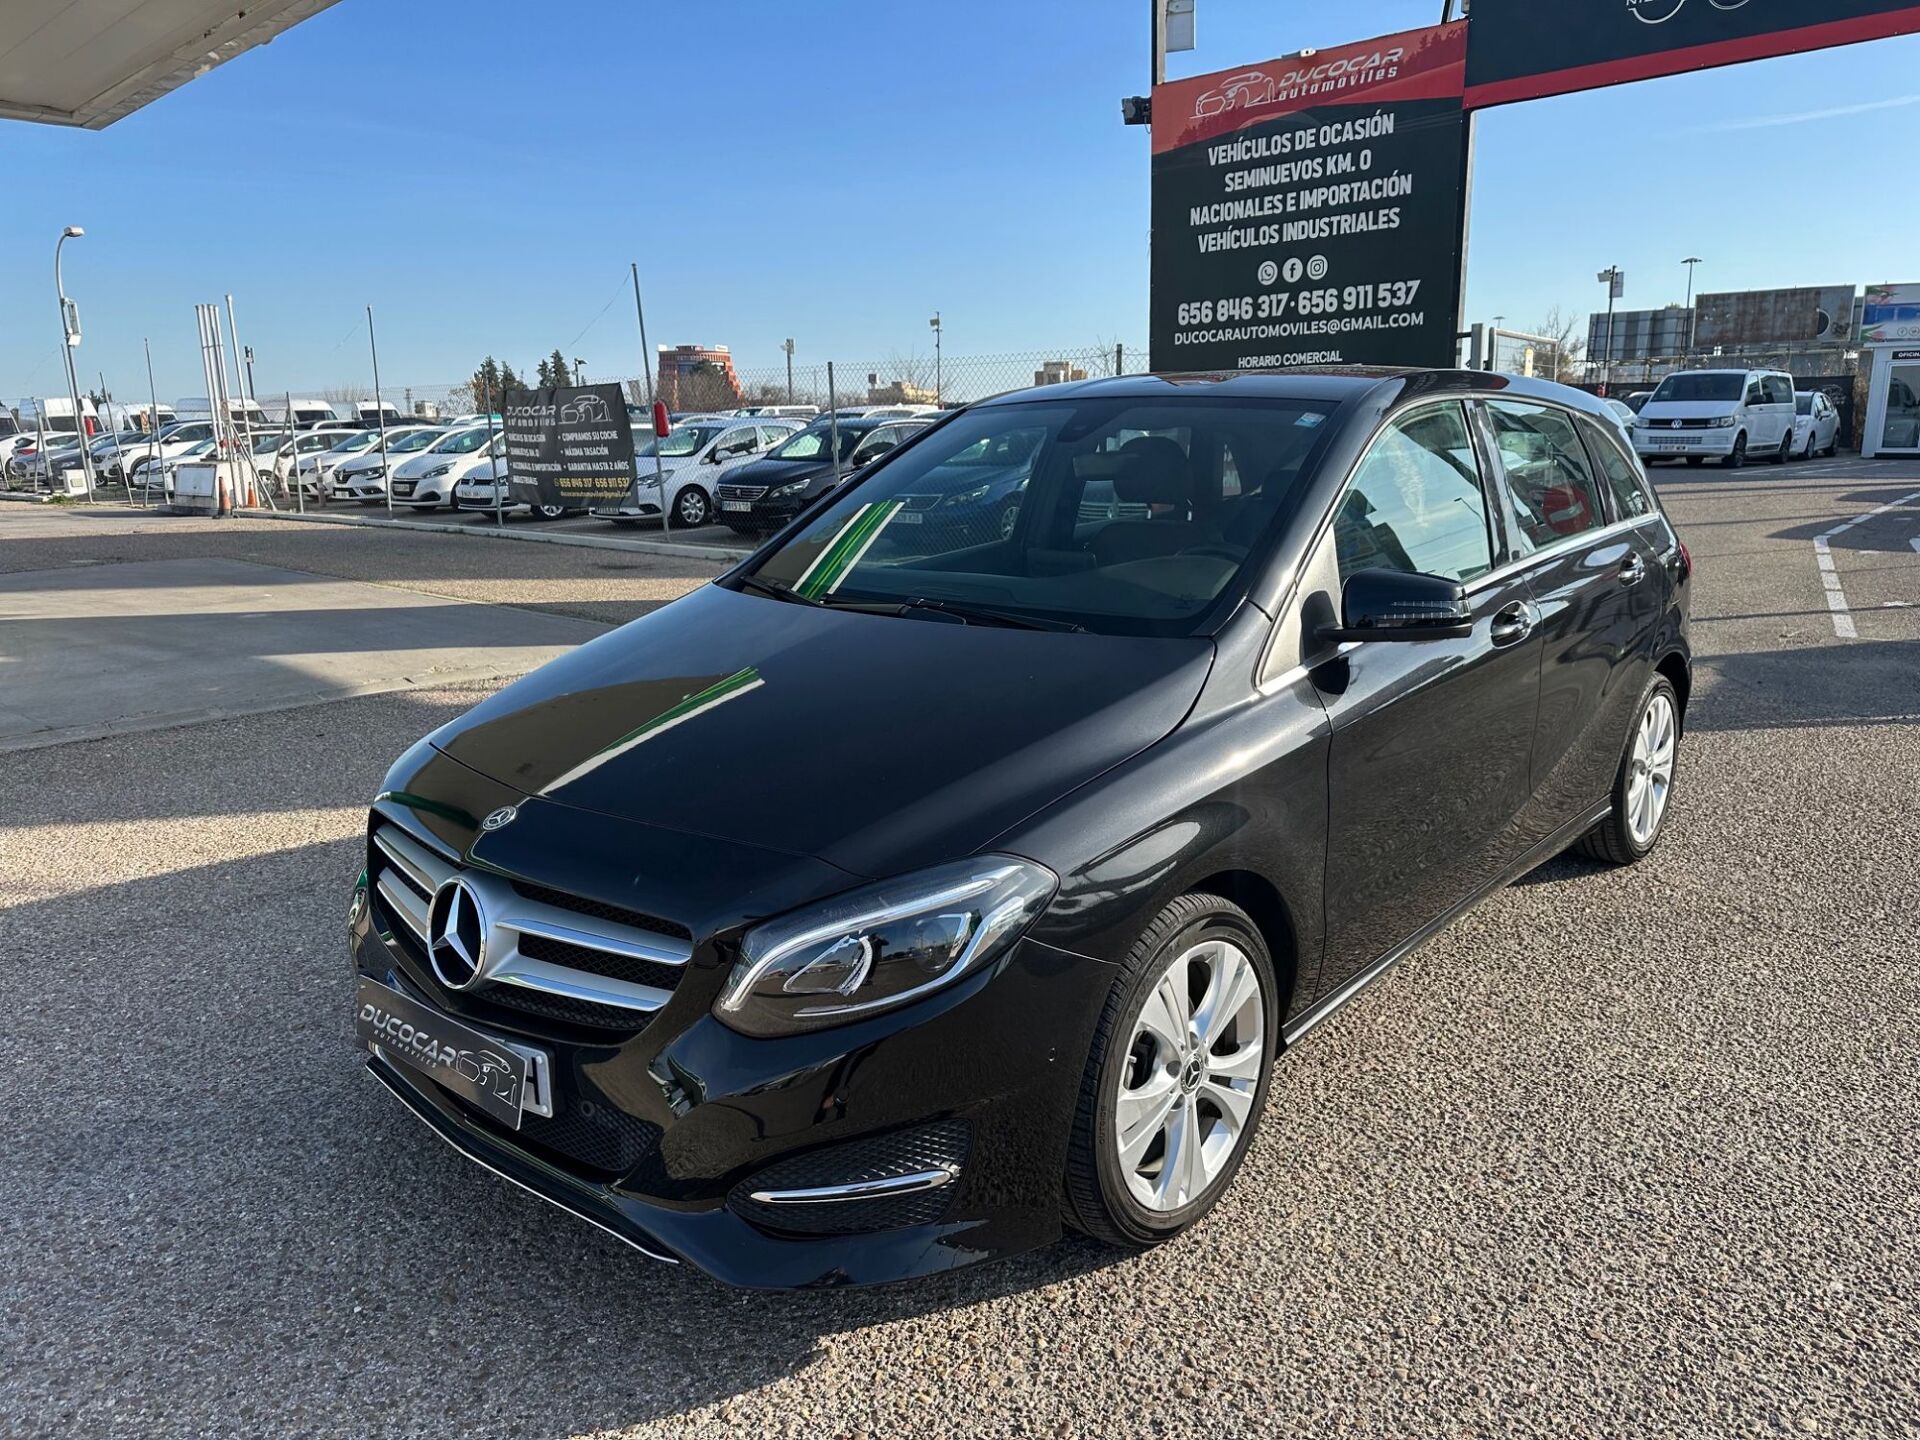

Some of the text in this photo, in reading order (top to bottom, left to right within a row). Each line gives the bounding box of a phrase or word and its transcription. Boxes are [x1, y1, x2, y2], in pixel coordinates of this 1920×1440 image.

[1279, 48, 1403, 89] DUCOCAR
[1208, 109, 1394, 166] VEHÍCULOS DE OCASIÓN
[1224, 157, 1323, 192] SEMINUEVOS
[1326, 154, 1356, 175] KM.
[1190, 170, 1412, 226] NACIONALES E IMPORTACIÓN
[1198, 207, 1400, 254] VEHÍCULOS INDUSTRIALES
[1178, 299, 1213, 325] 656
[1217, 296, 1253, 322] 846
[1343, 284, 1373, 310] 911
[1378, 280, 1420, 306] 537
[1174, 311, 1424, 346] DUCOCARAUTOMOVILES@GMAIL.COM
[1238, 350, 1343, 368] HORARIO COMERCIAL
[600, 430, 618, 439] COCHE
[592, 462, 609, 470] HASTA
[609, 462, 613, 470] 2
[614, 460, 629, 470] AÑOS
[360, 1004, 457, 1066] DUCOCAR
[374, 1030, 438, 1068] AUTOMOVILES
